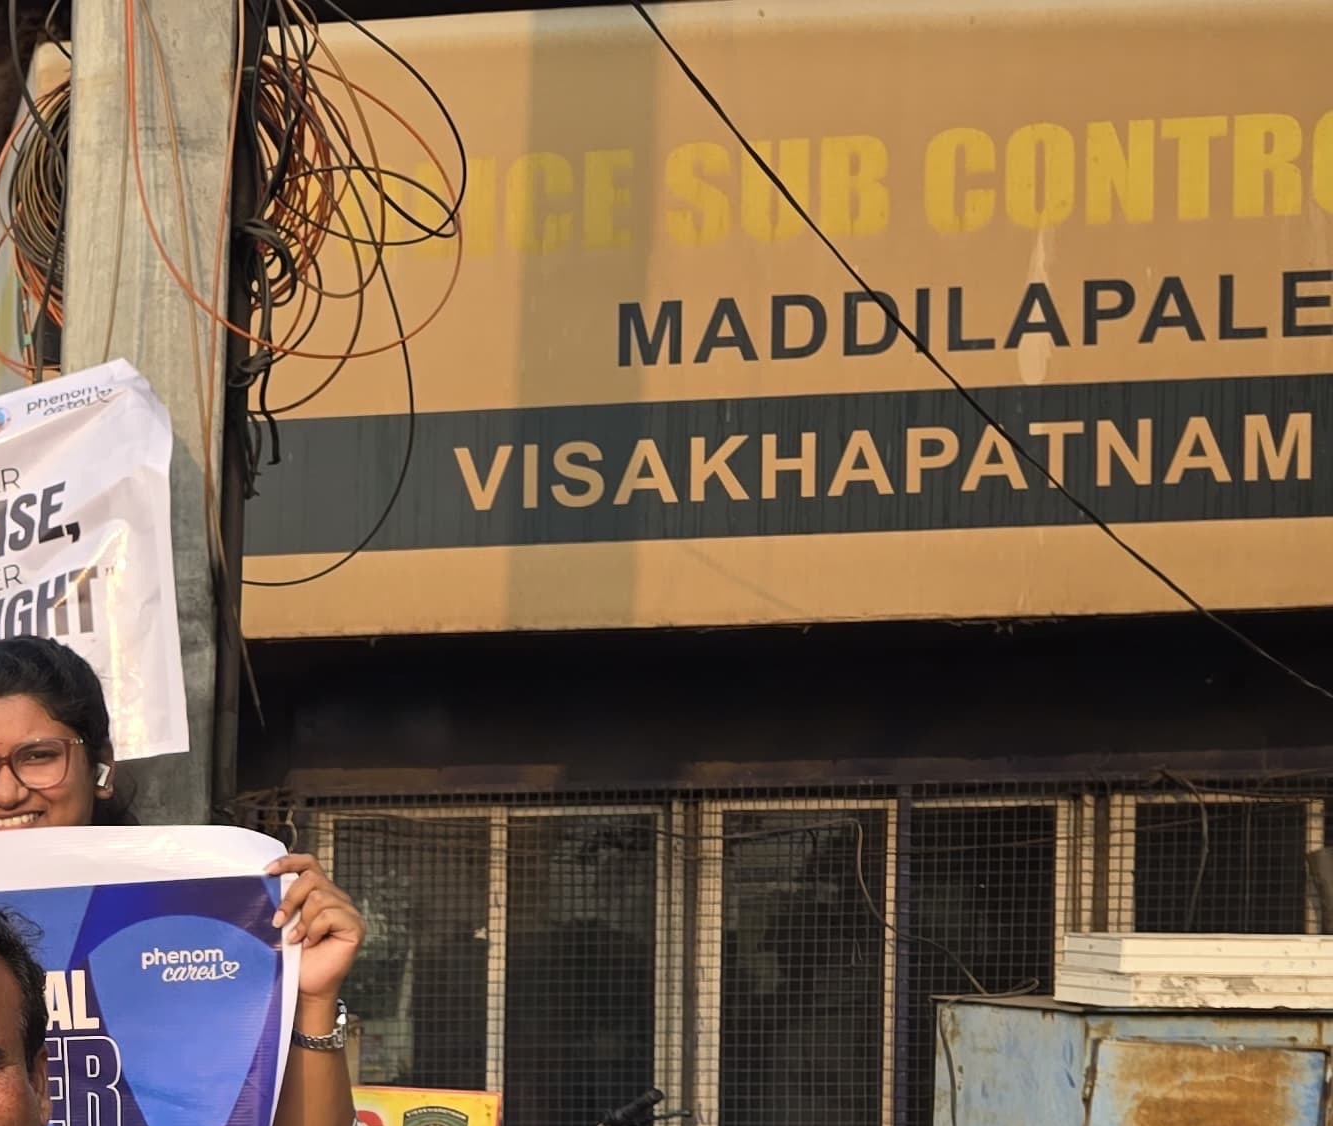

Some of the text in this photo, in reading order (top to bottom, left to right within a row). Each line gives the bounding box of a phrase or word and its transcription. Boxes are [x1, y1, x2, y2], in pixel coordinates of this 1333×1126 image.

[662, 133, 894, 248] SUB
[26, 385, 99, 415] phenom
[453, 412, 1312, 511] VISAKHAPATNAM
[141, 947, 224, 970] phenom
[162, 963, 222, 982] cares
